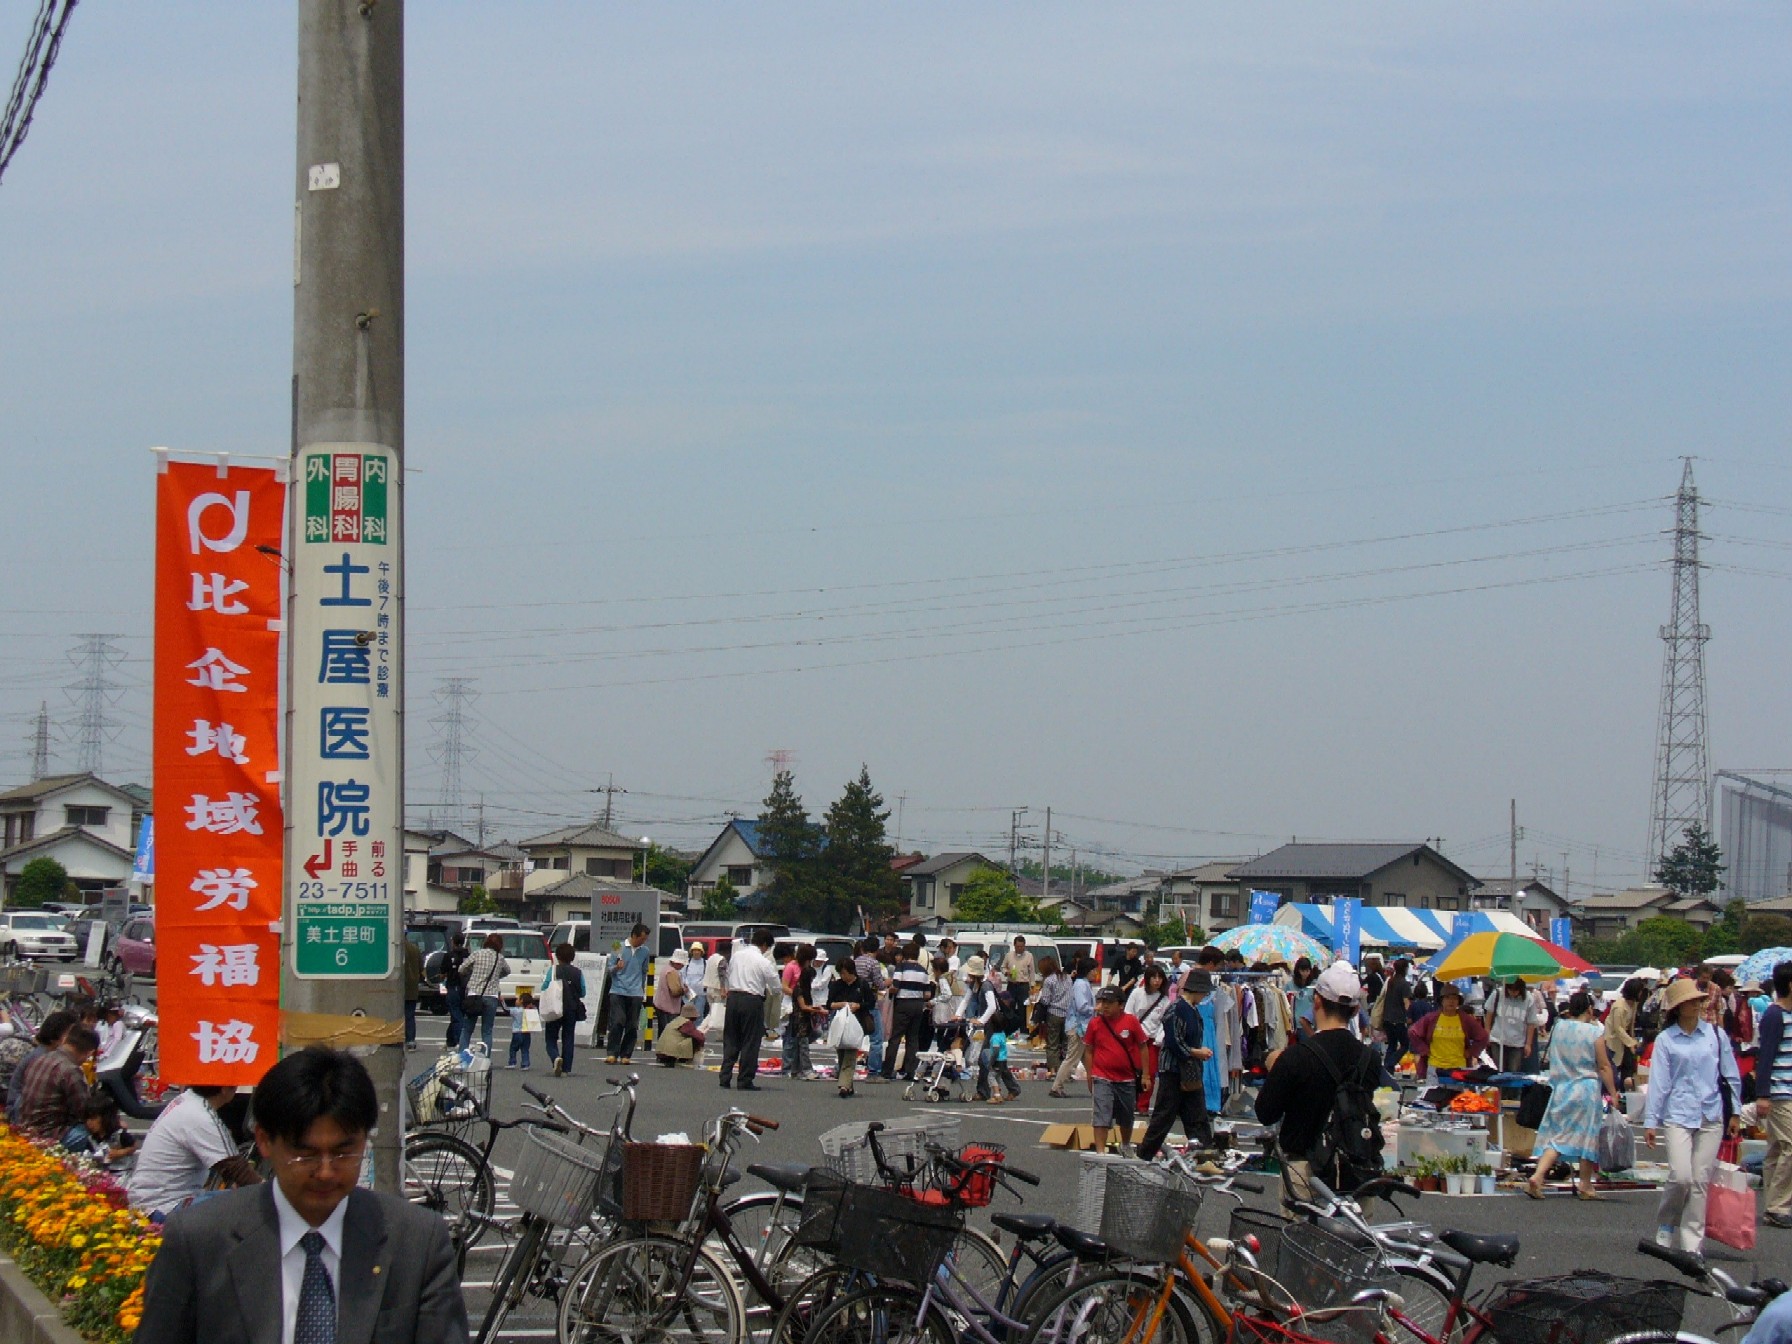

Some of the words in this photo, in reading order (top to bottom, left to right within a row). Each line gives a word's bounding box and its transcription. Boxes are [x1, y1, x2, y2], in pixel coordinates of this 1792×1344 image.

[306, 456, 330, 540] 外科
[333, 456, 360, 541] 胃腸科
[364, 457, 386, 541] 内科
[318, 552, 372, 838] 土屋医院
[184, 571, 264, 1064] 比企地域労福協
[299, 881, 388, 900] 23-7511
[306, 925, 376, 945] 美土里町
[335, 948, 349, 966] 6
